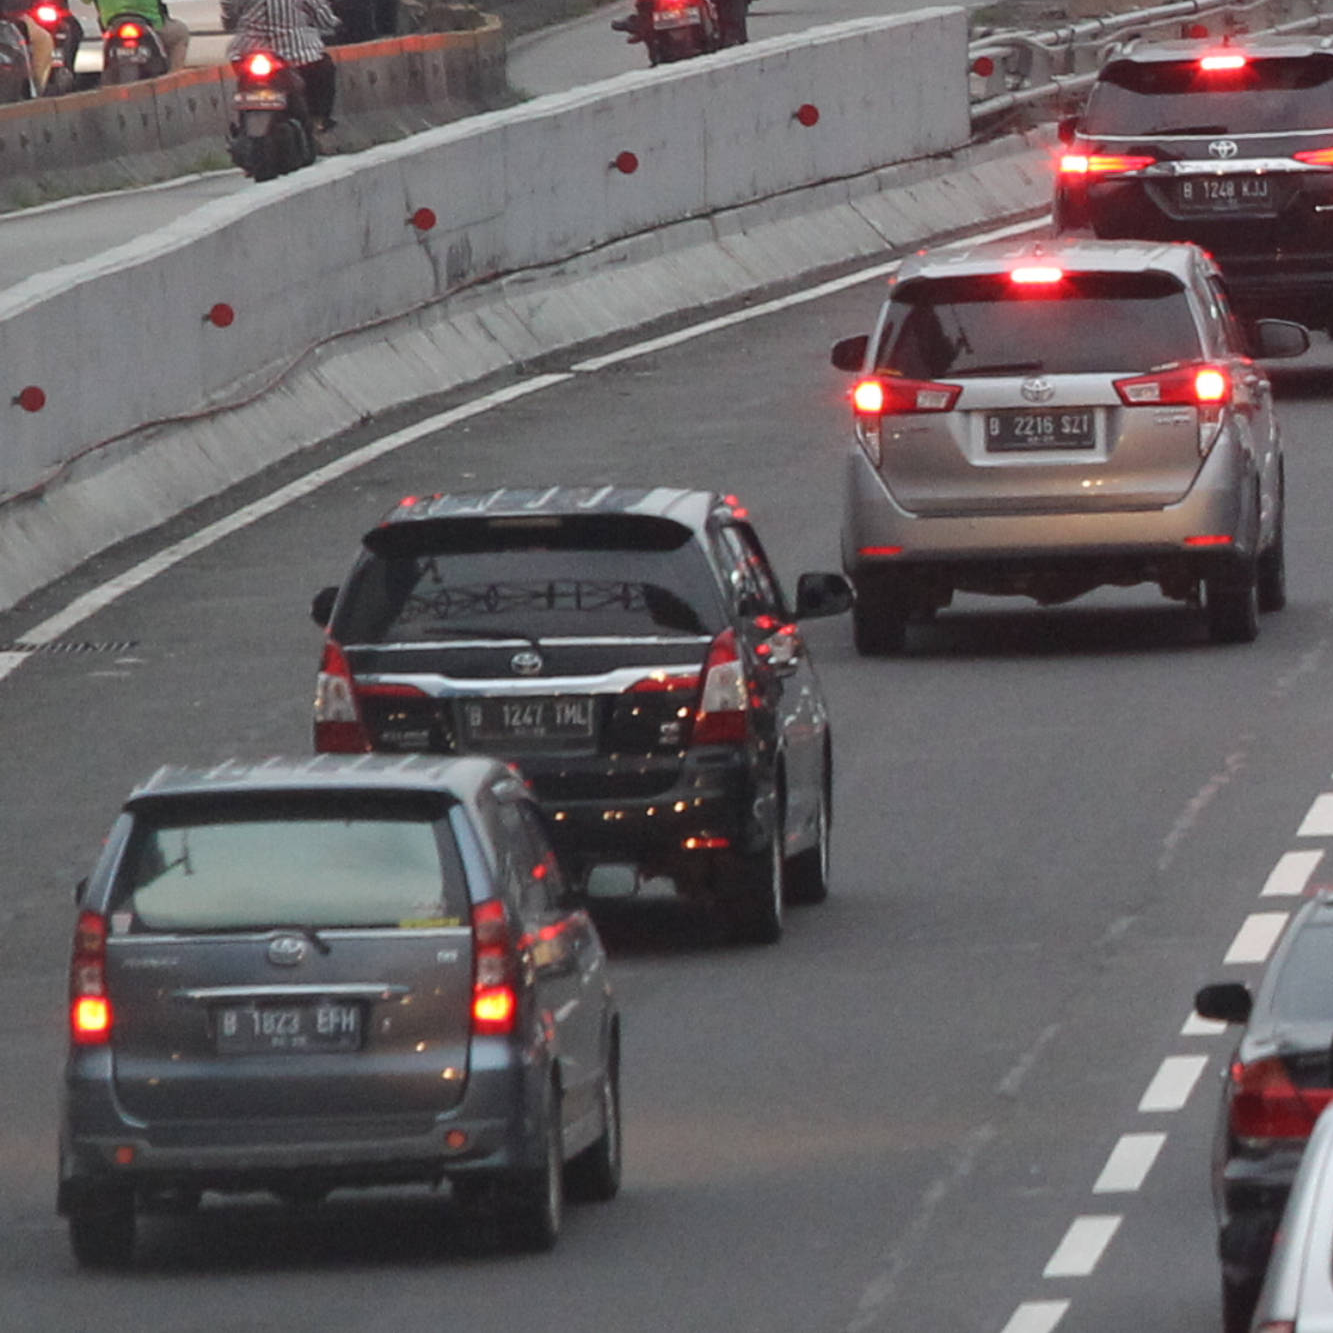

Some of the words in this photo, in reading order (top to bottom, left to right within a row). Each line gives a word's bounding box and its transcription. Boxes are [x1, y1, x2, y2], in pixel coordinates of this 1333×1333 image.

[1184, 182, 1193, 199] B
[988, 417, 1000, 436] B
[1014, 417, 1055, 436] 2216
[222, 1013, 237, 1037] B
